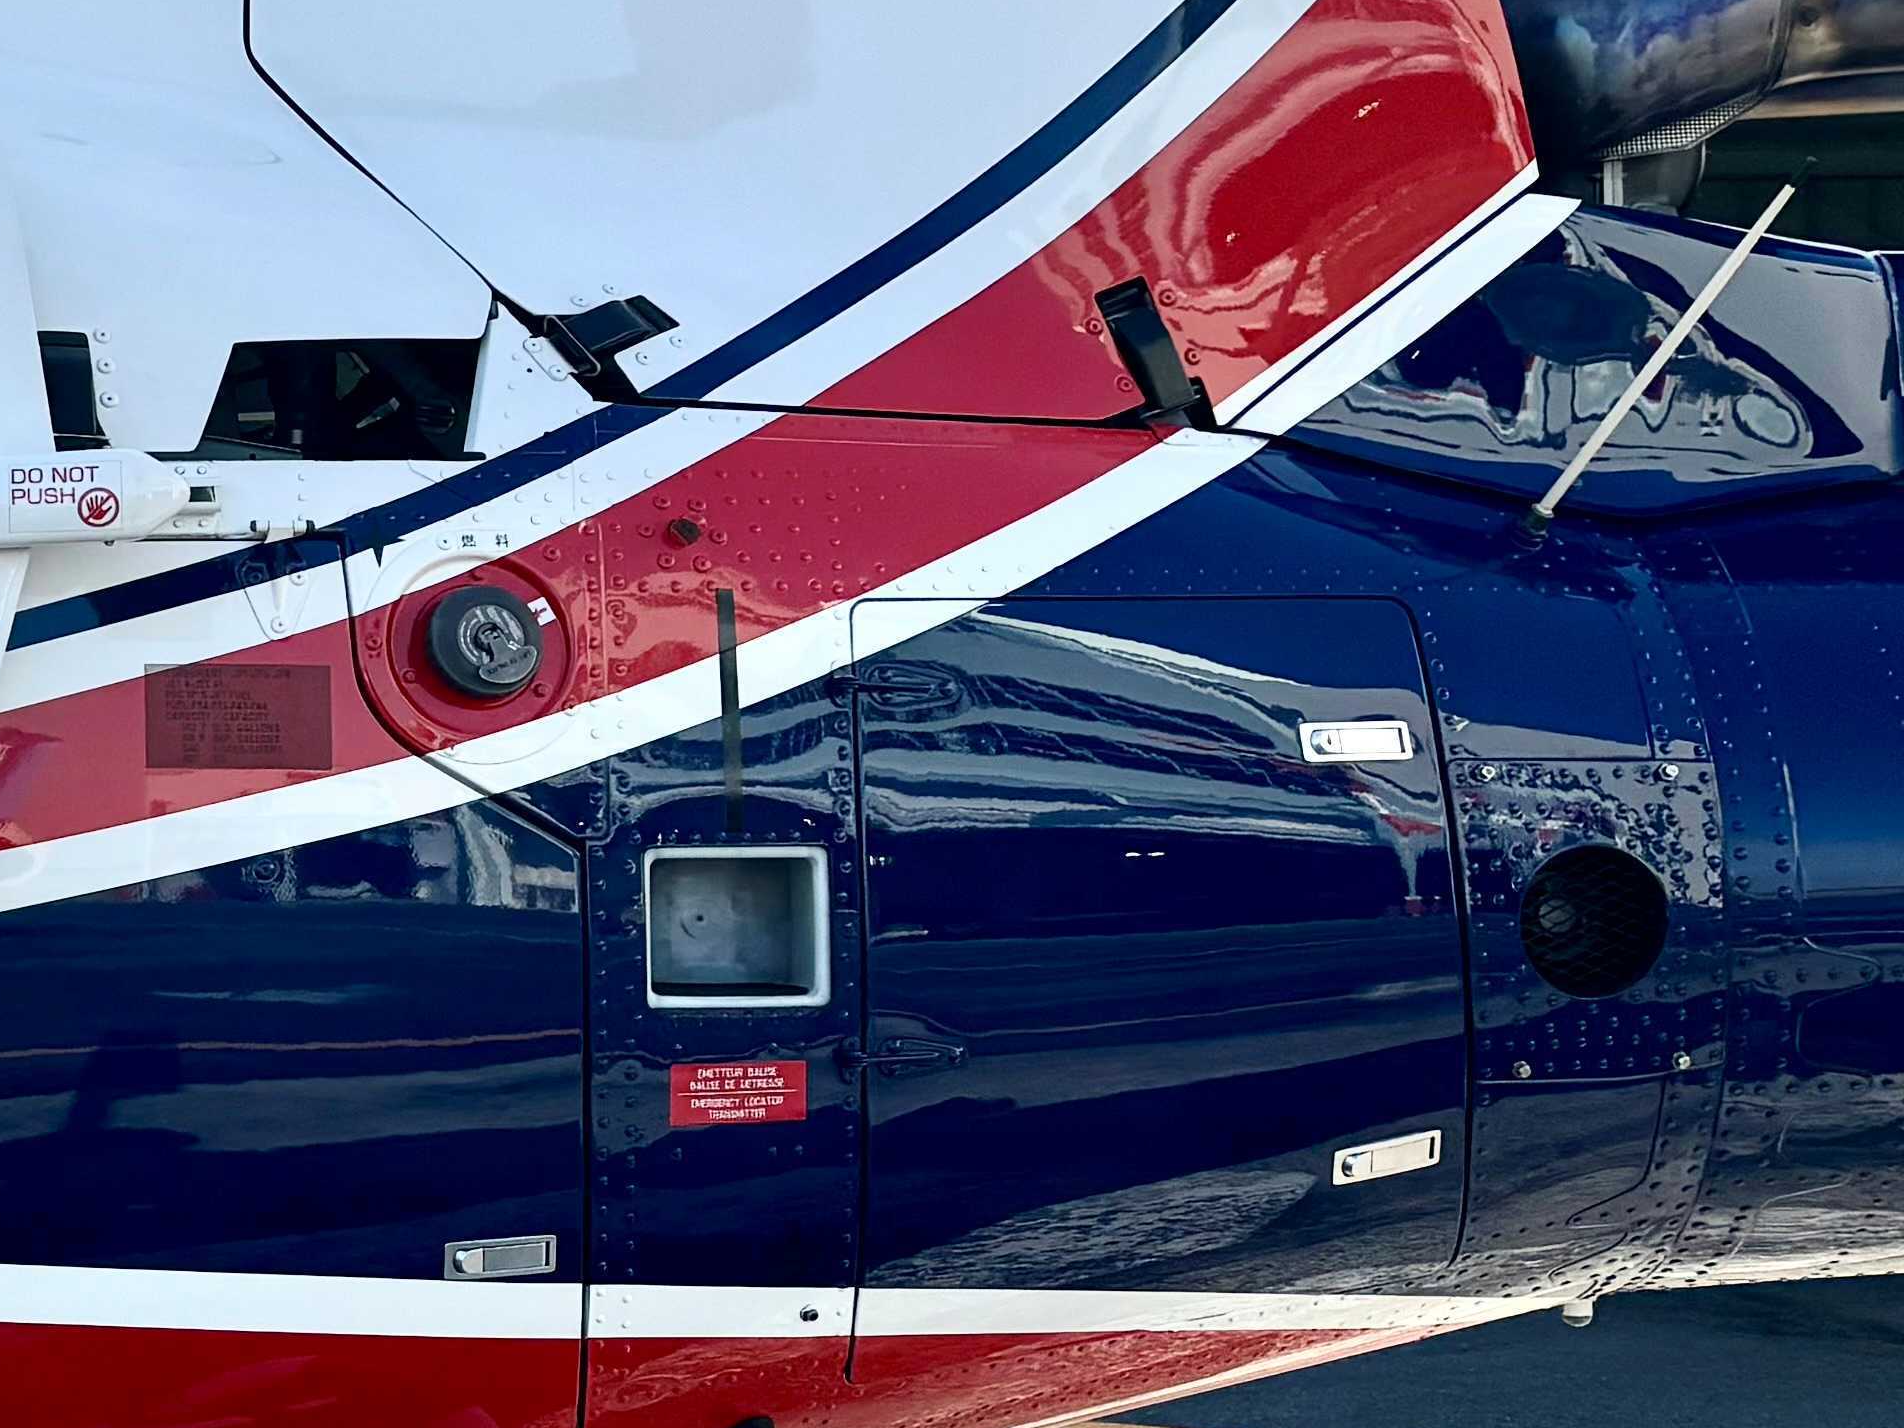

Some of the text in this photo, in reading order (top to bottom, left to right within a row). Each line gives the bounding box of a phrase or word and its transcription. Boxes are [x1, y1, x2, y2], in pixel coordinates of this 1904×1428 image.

[11, 466, 99, 484] DO NOT
[11, 487, 75, 505] PUSH
